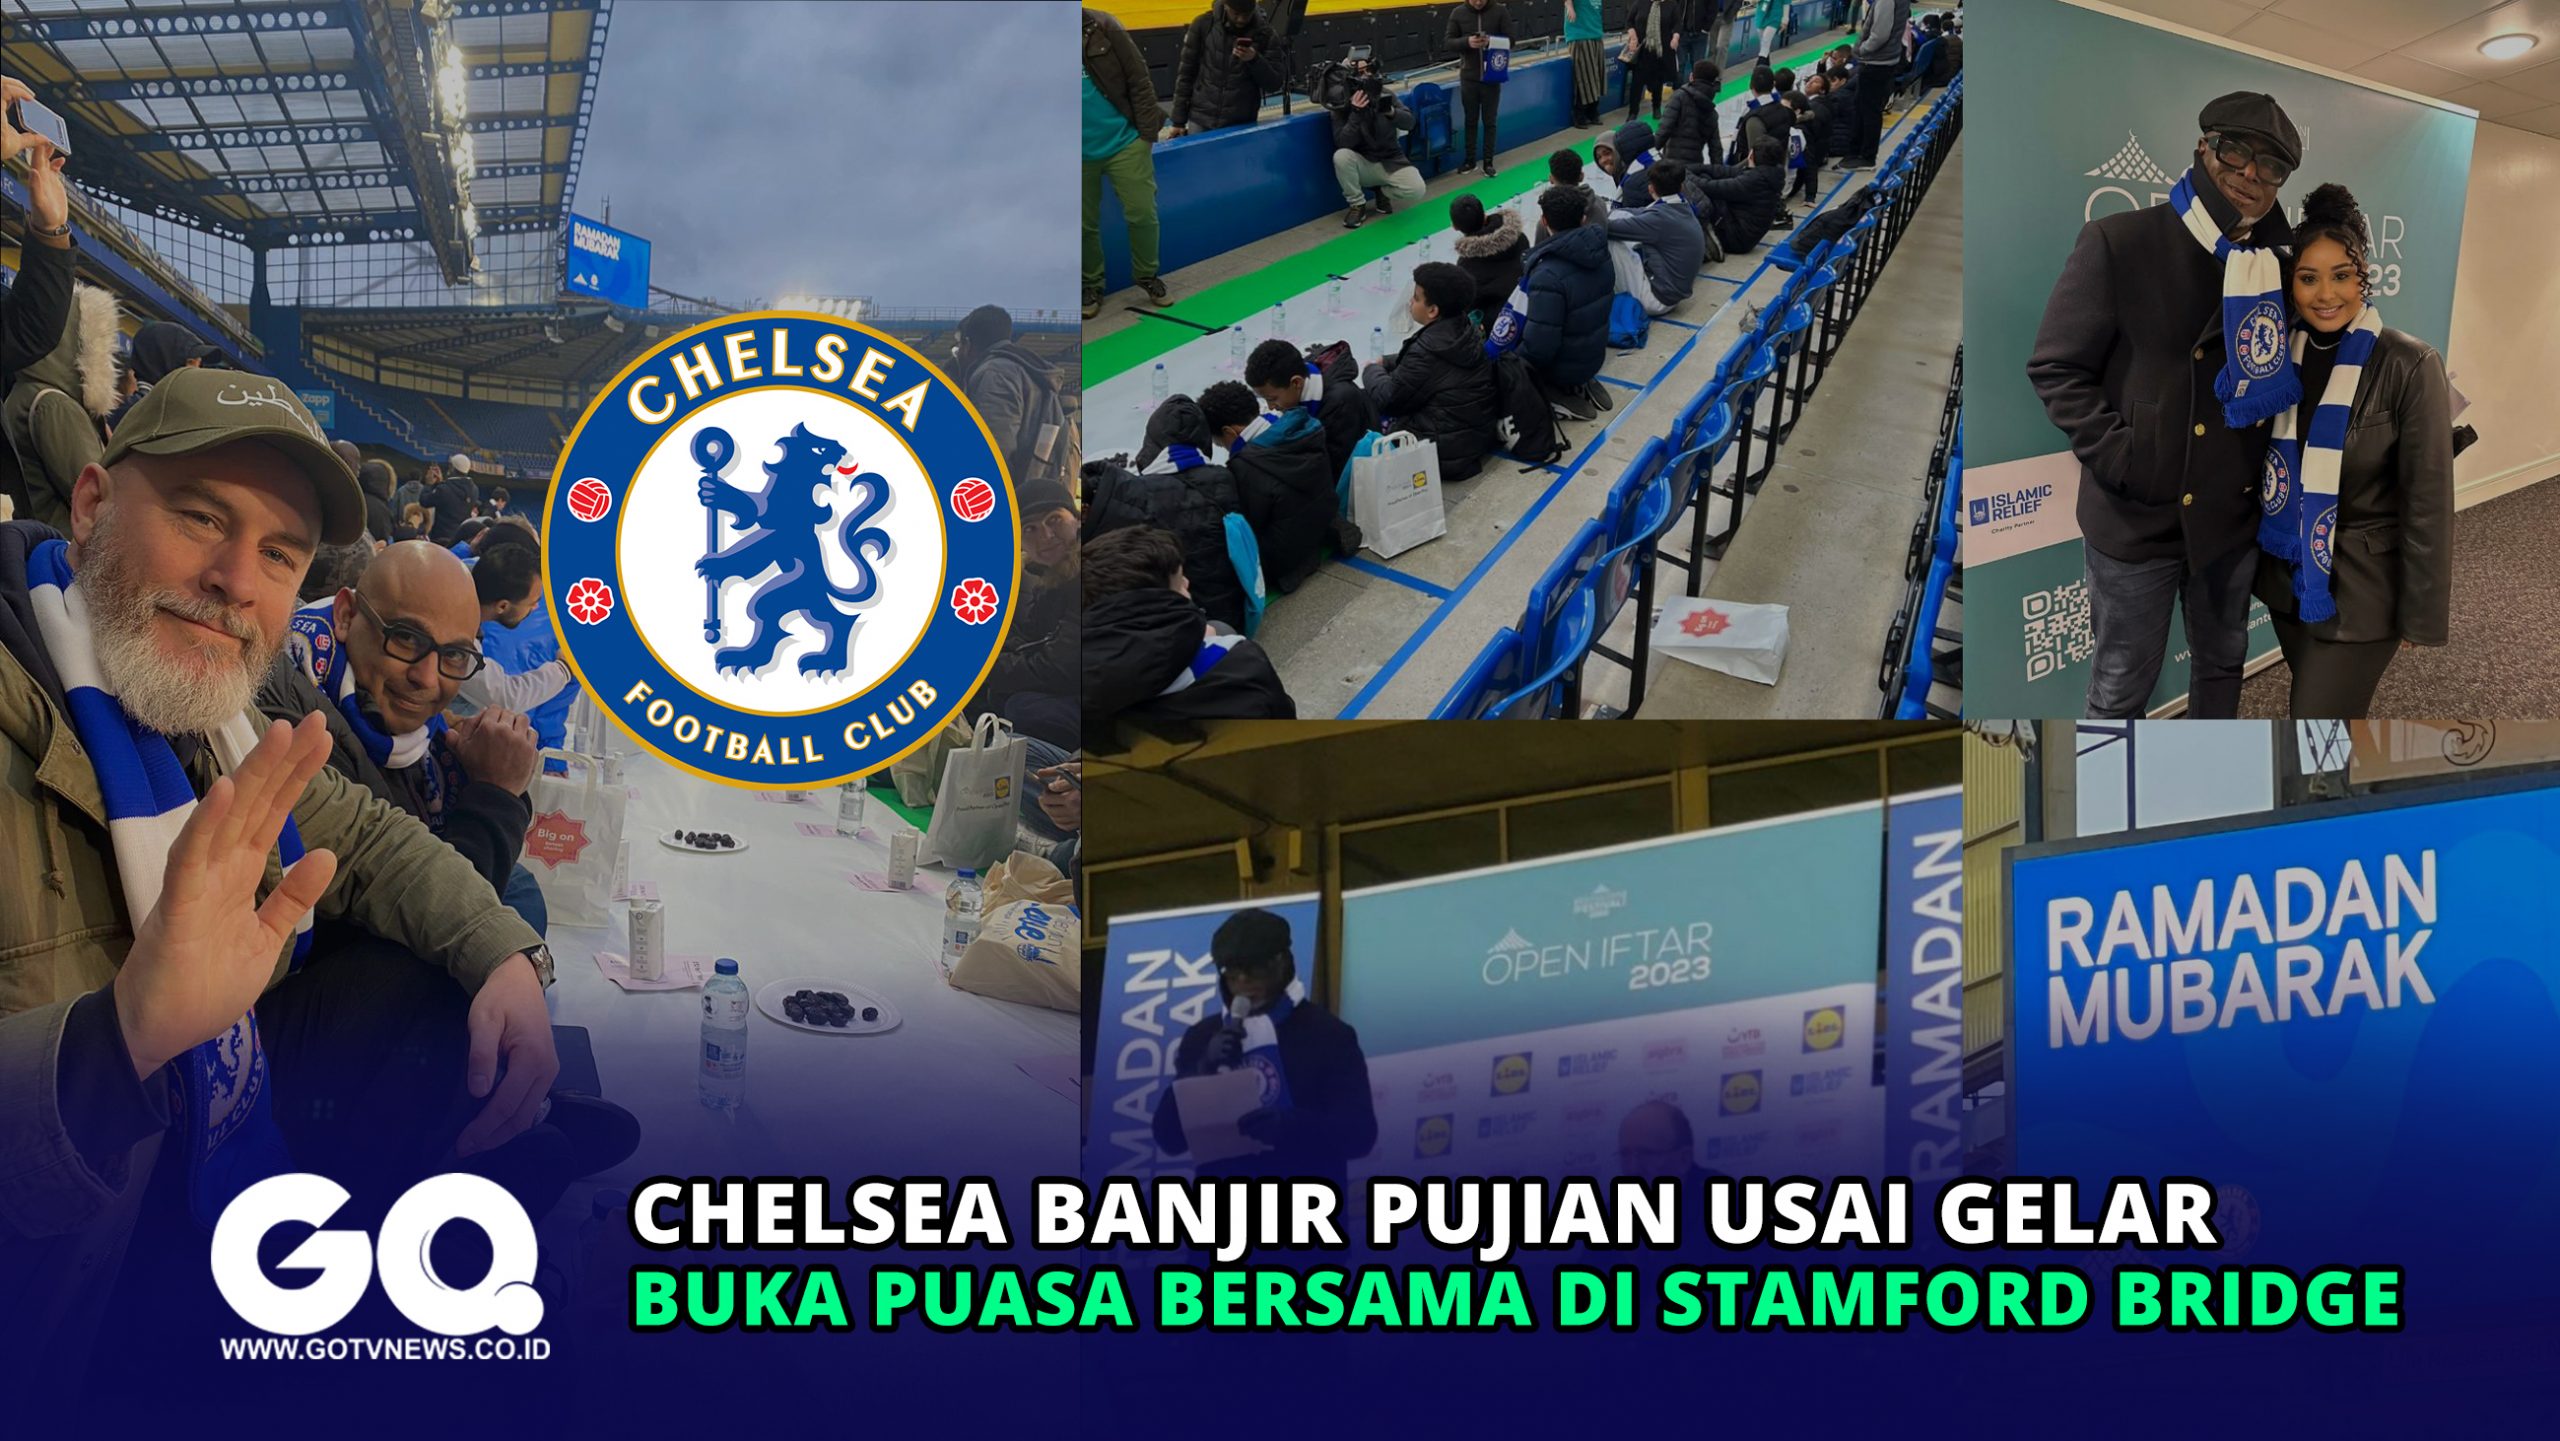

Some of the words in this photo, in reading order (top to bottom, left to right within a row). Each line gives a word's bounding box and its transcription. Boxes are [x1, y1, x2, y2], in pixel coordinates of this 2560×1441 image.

[573, 221, 621, 250] RAMADAN
[573, 233, 620, 261] MUBARAK
[1991, 484, 2052, 508] ISLAMIC
[1992, 499, 2042, 521] RELIEF
[1991, 525, 2013, 534] Charity
[2014, 519, 2036, 529] Partner
[537, 828, 557, 842] Big
[559, 834, 575, 842] on
[2047, 849, 2438, 972] RAMADAN
[1481, 940, 1591, 986] OPEN
[1600, 922, 1713, 969] IFTAR
[1628, 956, 1711, 990] 2023
[2047, 929, 2437, 1049] MUBARAK
[1911, 828, 1963, 1183] RAMADAN
[1106, 949, 1172, 1178] MADAN
